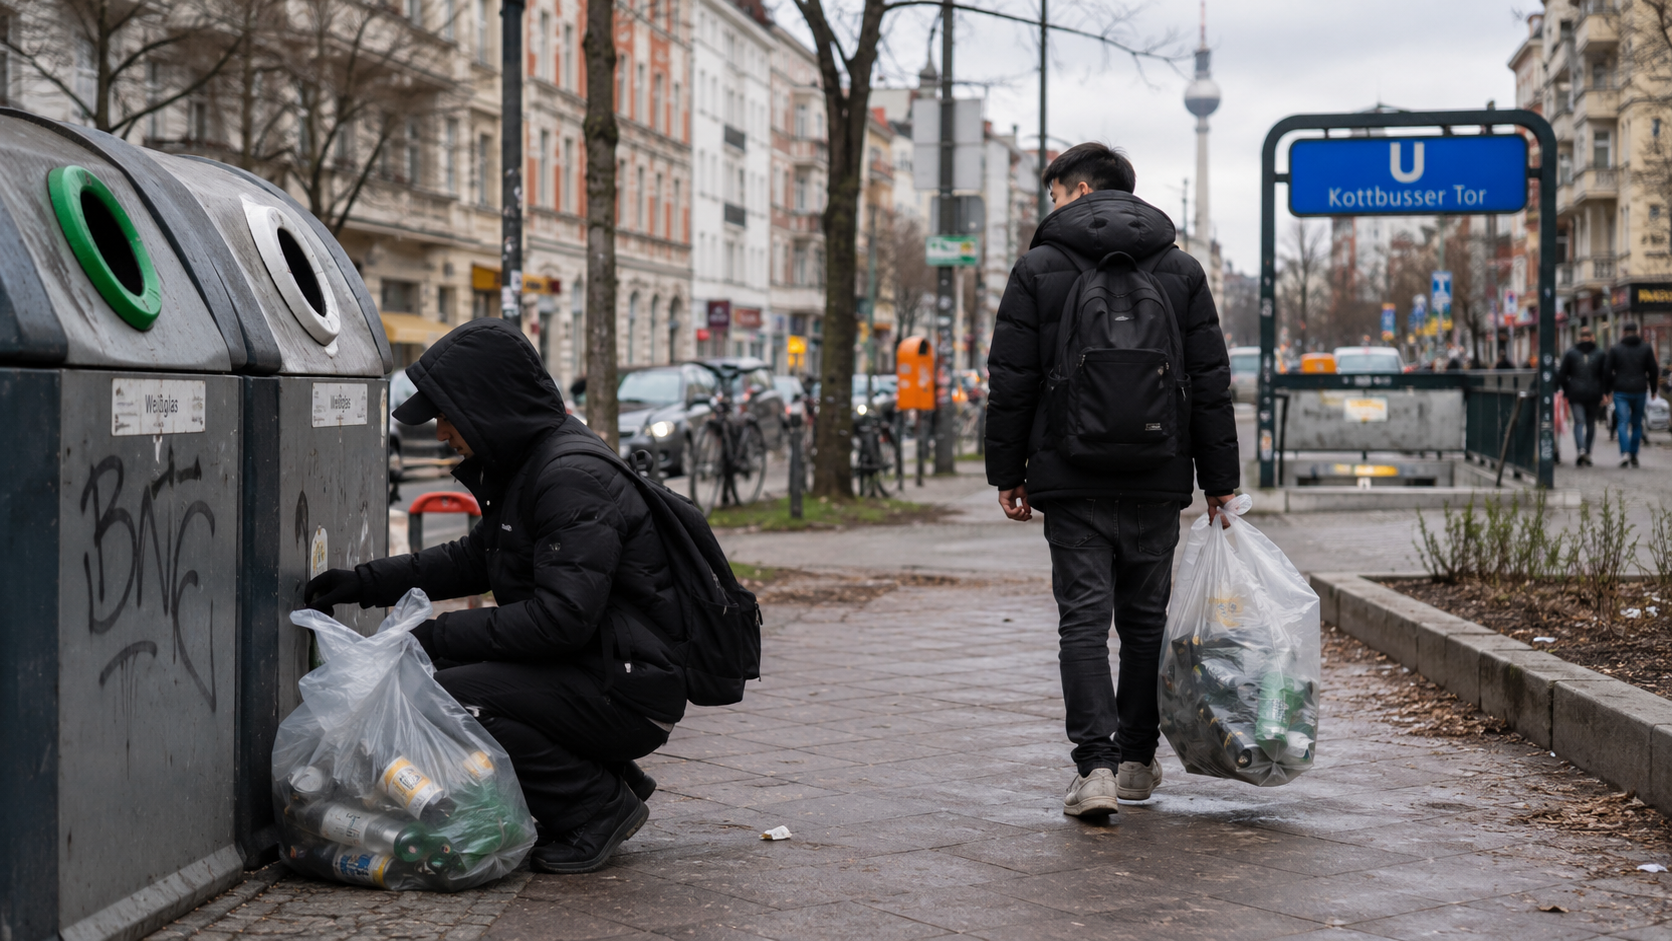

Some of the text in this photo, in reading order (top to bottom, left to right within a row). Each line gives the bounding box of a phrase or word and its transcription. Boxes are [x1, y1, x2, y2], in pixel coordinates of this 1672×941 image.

[1389, 141, 1425, 184] U
[1328, 184, 1488, 208] Kottbusser Tor
